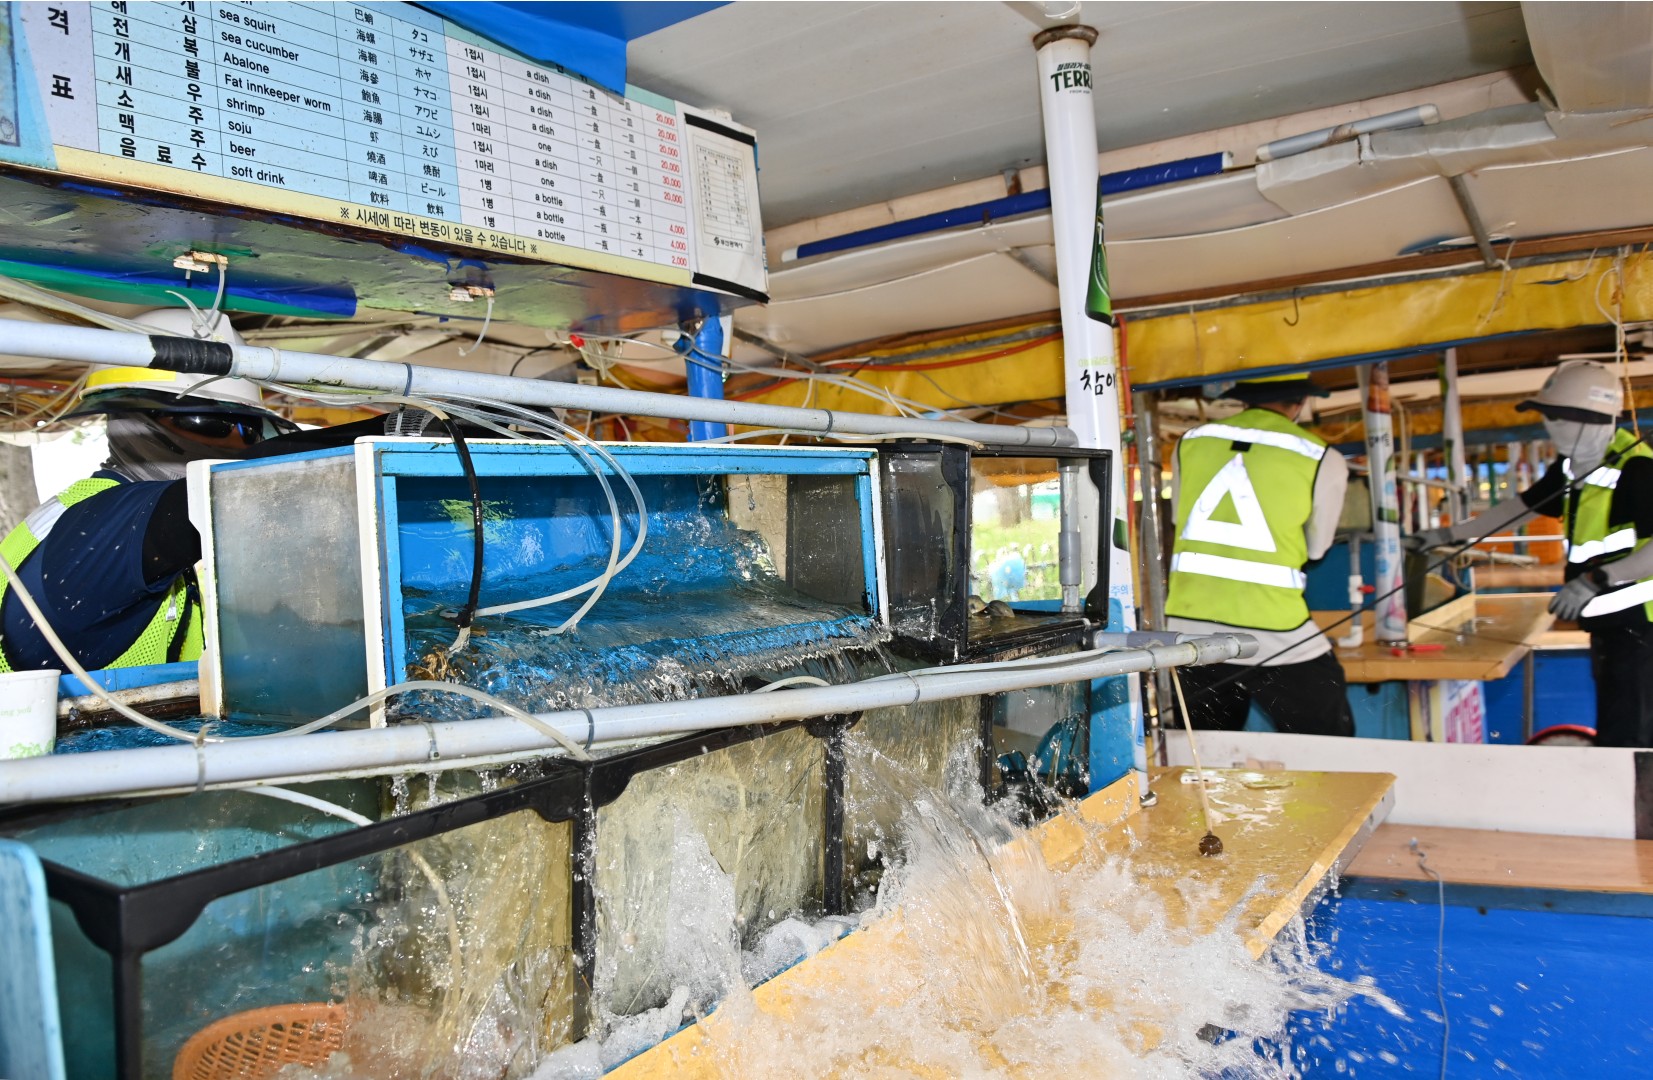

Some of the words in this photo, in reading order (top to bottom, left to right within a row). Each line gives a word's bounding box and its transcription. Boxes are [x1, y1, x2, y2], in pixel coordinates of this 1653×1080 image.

[48, 7, 69, 35] 격
[182, 15, 197, 34] 삼
[219, 9, 240, 23] sea
[243, 16, 276, 34] squirt
[113, 17, 129, 38] 전
[183, 36, 198, 57] 복
[411, 28, 428, 43] タコ
[221, 31, 242, 45] sea
[245, 38, 299, 62] cucumber
[114, 41, 130, 62] 개
[184, 59, 200, 80] 불
[408, 46, 435, 63] サザエ
[464, 47, 484, 63] 1접시
[223, 51, 270, 74] Abalone
[414, 66, 432, 81] ホヤ
[466, 66, 486, 81] 1접시
[526, 70, 532, 78] a
[533, 71, 550, 84] dish
[51, 74, 74, 100] 표
[115, 65, 132, 86] 새
[186, 83, 202, 101] 우
[224, 73, 243, 89] Fat
[246, 77, 300, 104] innkeeper
[303, 95, 331, 111] worm
[413, 85, 437, 101] ナマコ
[468, 84, 488, 100] 1접시
[528, 87, 534, 96] a
[535, 89, 552, 101] dish
[117, 90, 134, 108] 소
[188, 106, 204, 124] 주
[226, 97, 265, 116] shrimp
[414, 105, 438, 121] アワビ
[469, 103, 490, 118] 1접시
[530, 105, 536, 113] a
[537, 106, 554, 119] dish
[118, 113, 134, 134] 맥
[190, 129, 205, 148] 주
[228, 119, 252, 134] soju
[416, 125, 441, 139] ユムシ
[471, 121, 491, 137] 1마리
[531, 123, 537, 131] a
[538, 124, 555, 136] dish
[119, 137, 135, 158] 음
[156, 145, 173, 164] 료
[191, 152, 207, 171] 수
[230, 141, 256, 157] beer
[422, 144, 439, 158] えび
[473, 140, 493, 155] 1접시
[537, 141, 552, 152] one
[474, 159, 495, 174] 1마리
[535, 158, 541, 167] a
[542, 159, 558, 172] dish
[231, 164, 254, 179] soft
[256, 168, 285, 185] drink
[421, 182, 447, 197] ビール
[480, 178, 493, 191] 1병
[540, 177, 555, 188] one
[481, 197, 494, 210] 1병
[535, 193, 541, 202] a
[542, 193, 564, 207] bottle
[483, 215, 496, 228] 1병
[536, 211, 542, 220] a
[543, 211, 565, 225] bottle
[356, 209, 390, 228] 시세에
[394, 215, 416, 233] 따라
[420, 221, 451, 239] 변동이
[454, 227, 474, 243] 있을
[477, 232, 487, 246] 수
[490, 234, 526, 253] 있습니다
[537, 229, 543, 238] a
[544, 229, 566, 243] bottle
